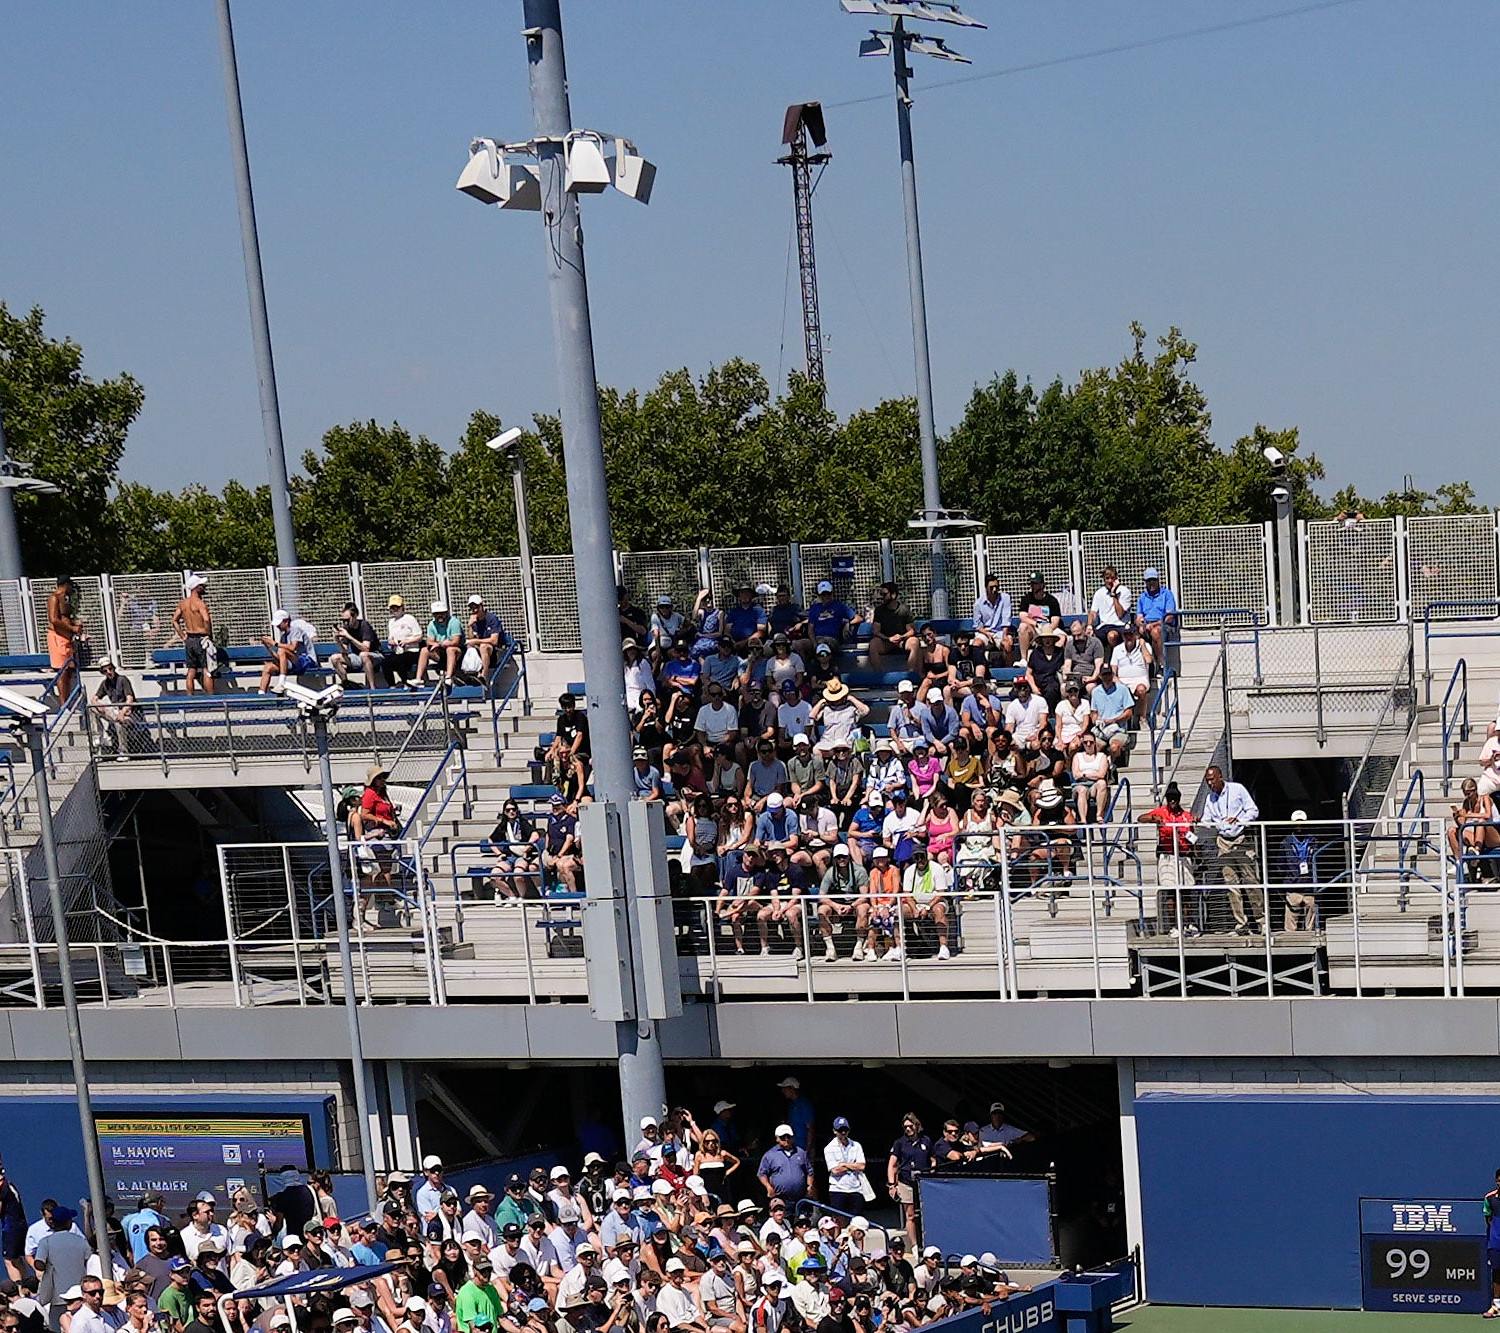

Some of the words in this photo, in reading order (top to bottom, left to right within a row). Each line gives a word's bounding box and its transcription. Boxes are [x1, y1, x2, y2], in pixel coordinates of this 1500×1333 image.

[1391, 1204, 1456, 1232] IBM
[1386, 1249, 1430, 1279] 99
[1446, 1268, 1475, 1281] MPH
[1392, 1293, 1426, 1304] SERVE
[1428, 1294, 1461, 1304] SPEED
